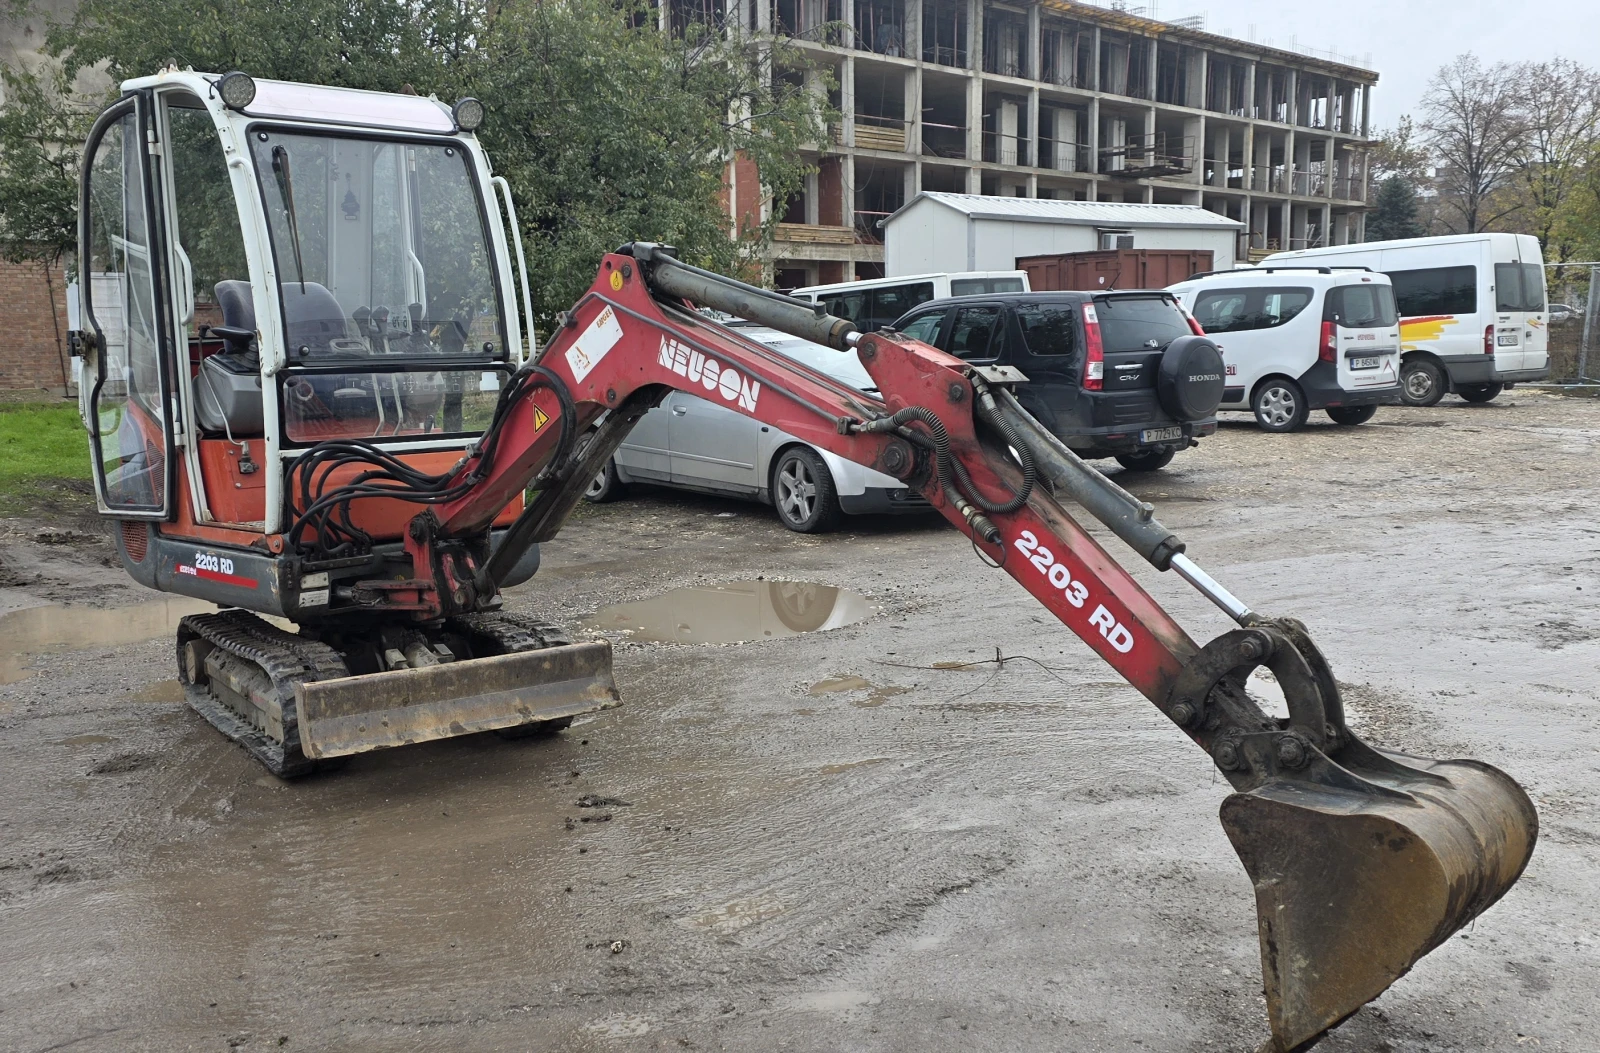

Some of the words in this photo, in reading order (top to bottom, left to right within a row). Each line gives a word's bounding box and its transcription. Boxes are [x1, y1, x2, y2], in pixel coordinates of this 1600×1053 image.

[657, 333, 760, 413] NEUSON
[1189, 373, 1221, 382] HONDA
[1147, 431, 1152, 441] P
[1154, 429, 1171, 440] 7729
[195, 553, 219, 572] 2203
[220, 557, 234, 575] RD
[1014, 530, 1089, 608] 2203
[1088, 603, 1134, 653] RD
